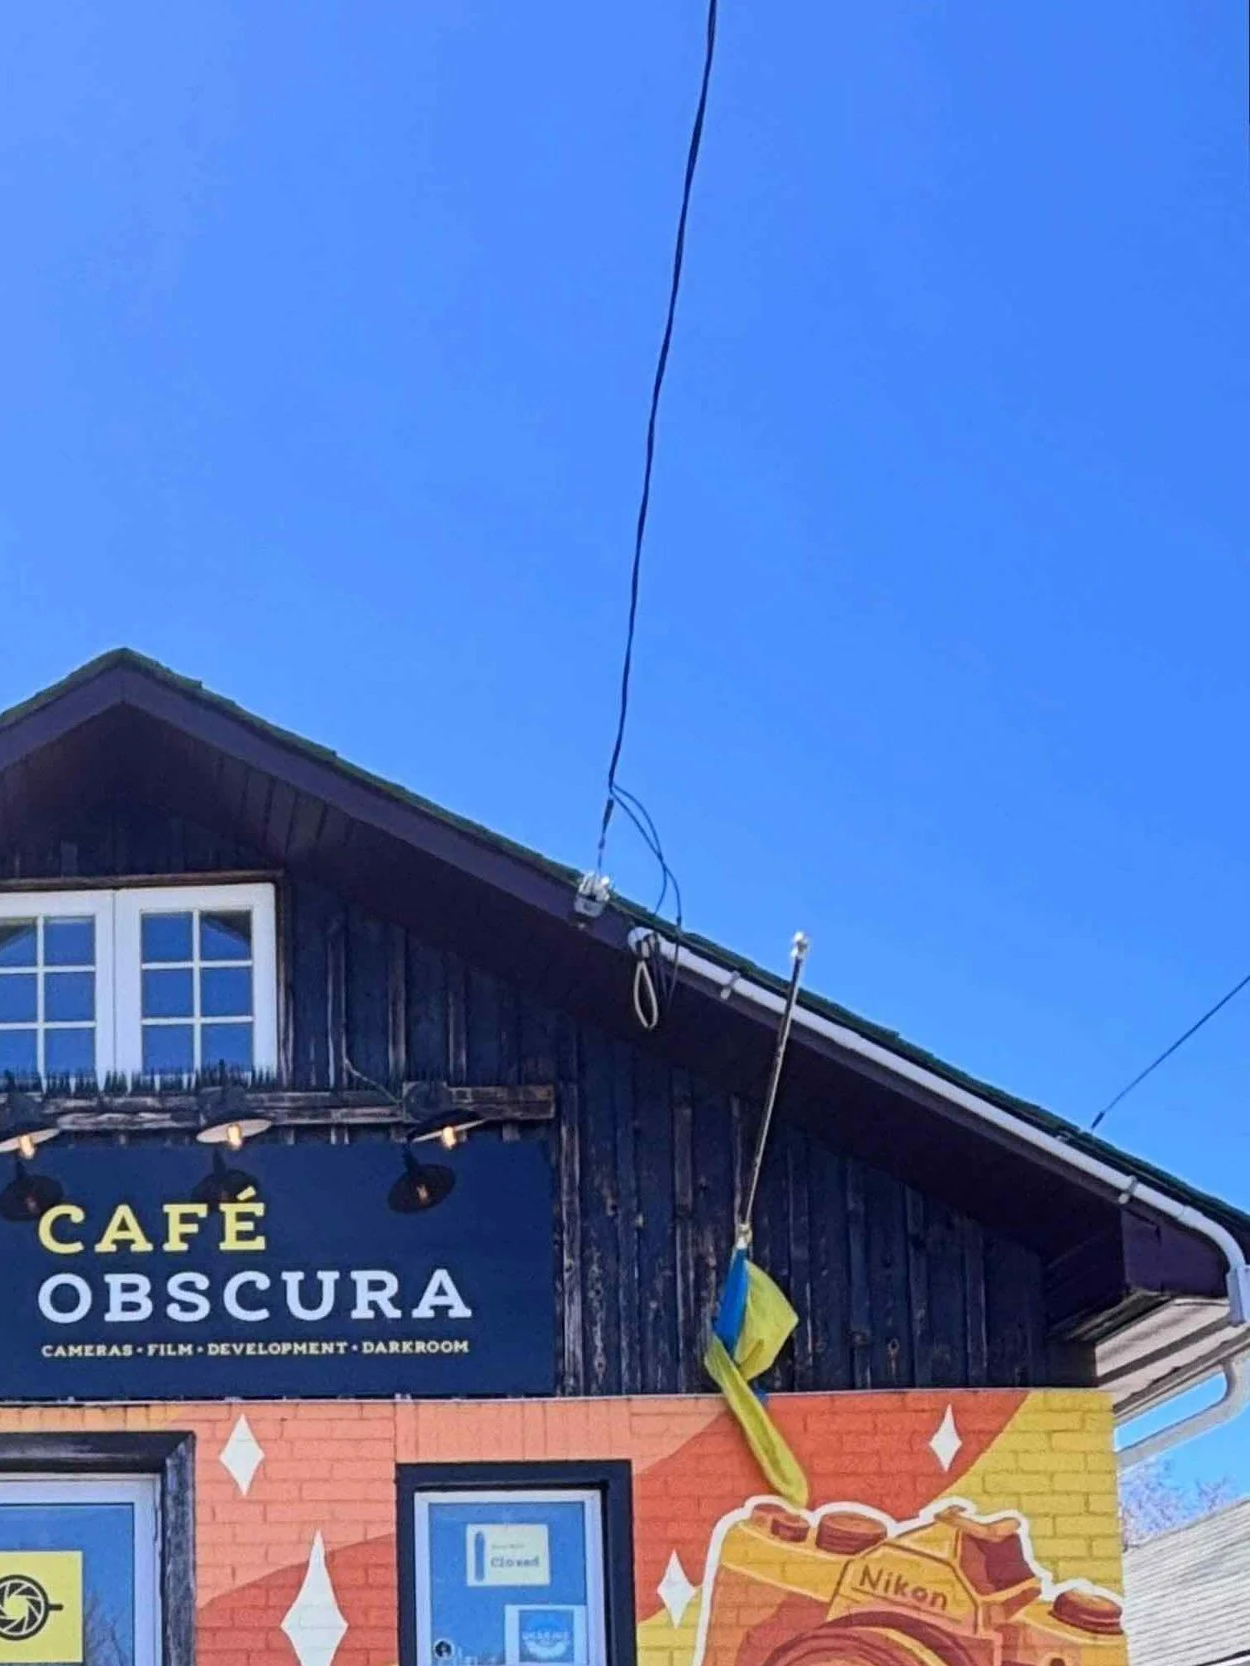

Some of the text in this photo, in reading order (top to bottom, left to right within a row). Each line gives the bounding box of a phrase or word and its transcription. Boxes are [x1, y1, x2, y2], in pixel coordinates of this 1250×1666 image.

[37, 1186, 266, 1254] CAFÉ
[37, 1269, 472, 1324] OBSCURA
[41, 1339, 470, 1358] CAMERAS FILM DEVELOPMENT DARKROOM
[490, 1555, 540, 1569] Closed
[858, 1563, 947, 1612] Nikon
